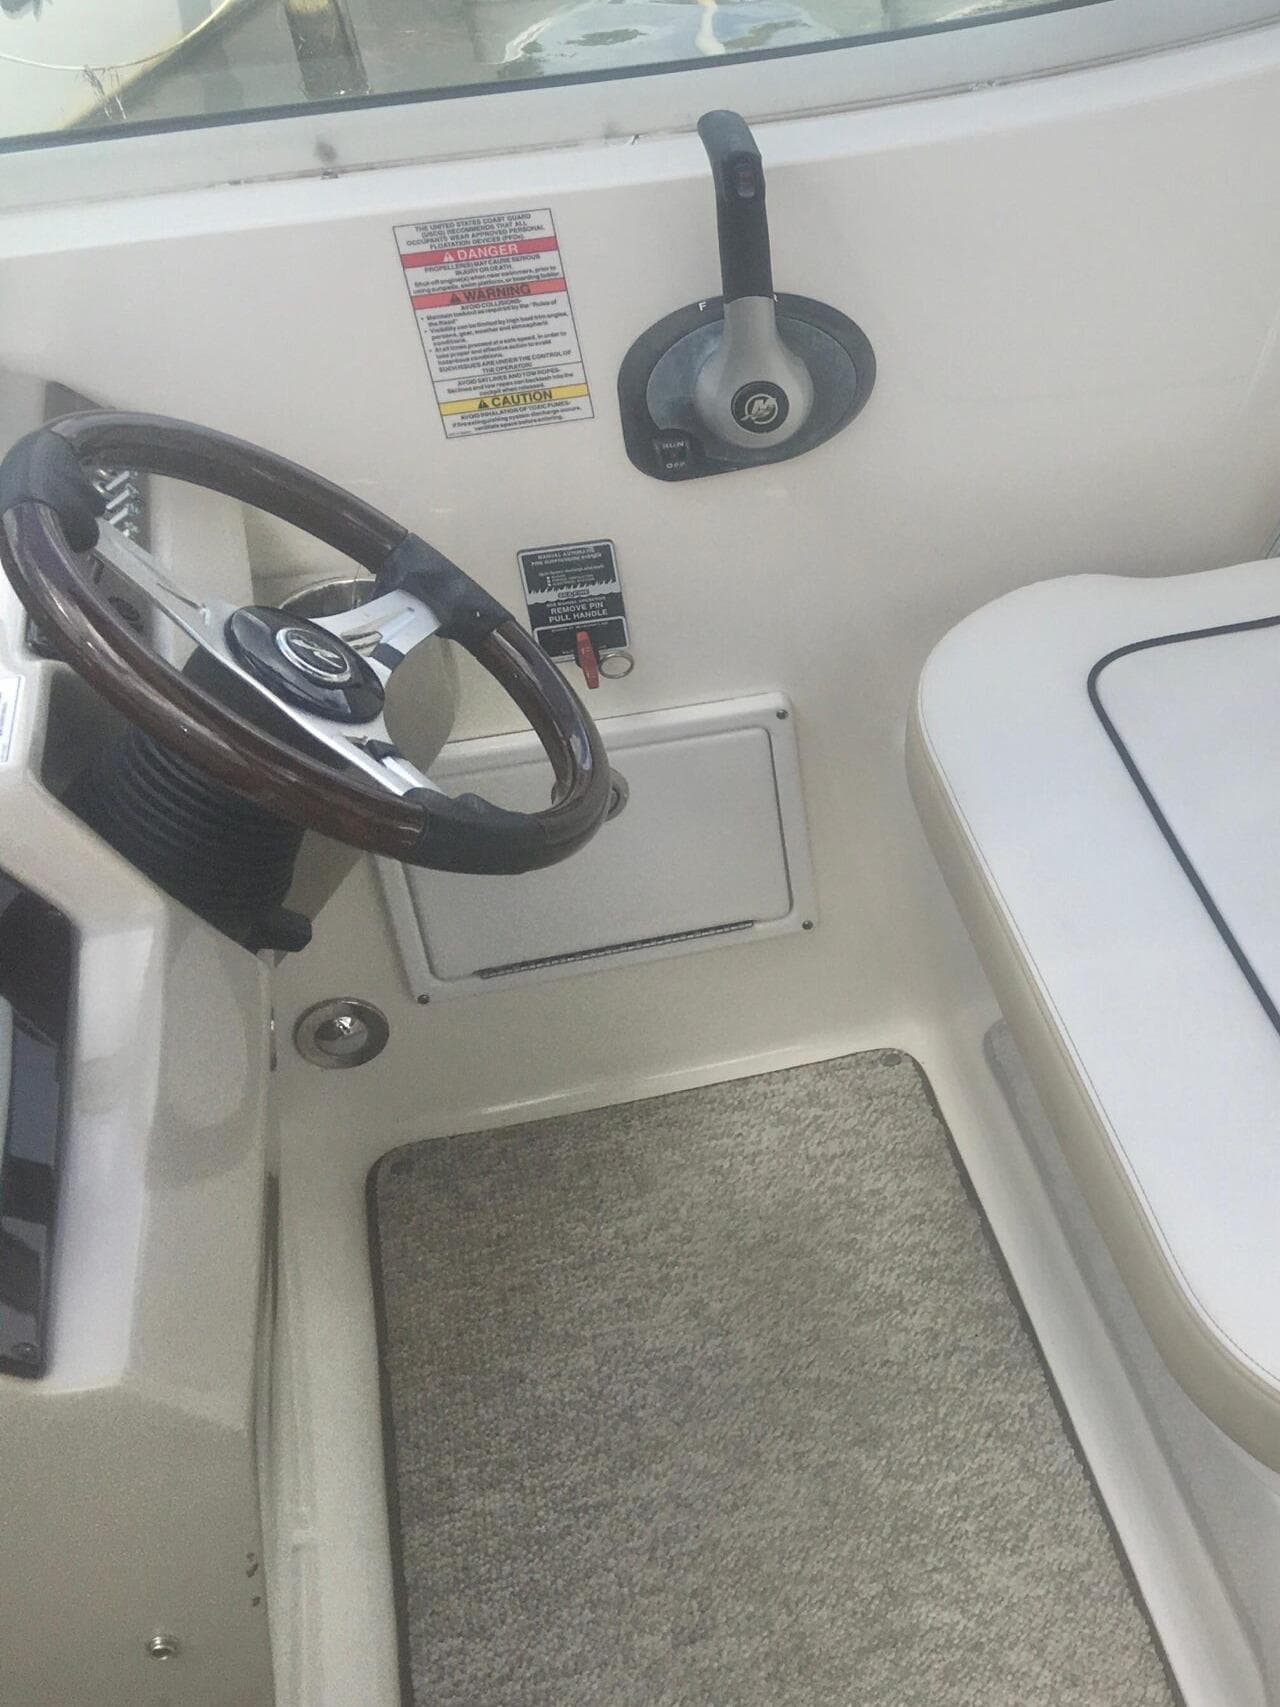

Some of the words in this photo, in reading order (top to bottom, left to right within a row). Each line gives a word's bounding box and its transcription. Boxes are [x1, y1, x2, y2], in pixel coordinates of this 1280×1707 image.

[456, 243, 518, 260] DANGER
[462, 283, 531, 301] WARNING
[698, 301, 707, 312] F
[490, 390, 553, 407] CAUTION
[550, 604, 587, 614] REMOVE
[588, 601, 604, 609] PIN
[548, 614, 570, 622] PULL
[572, 609, 608, 619] HANDLE
